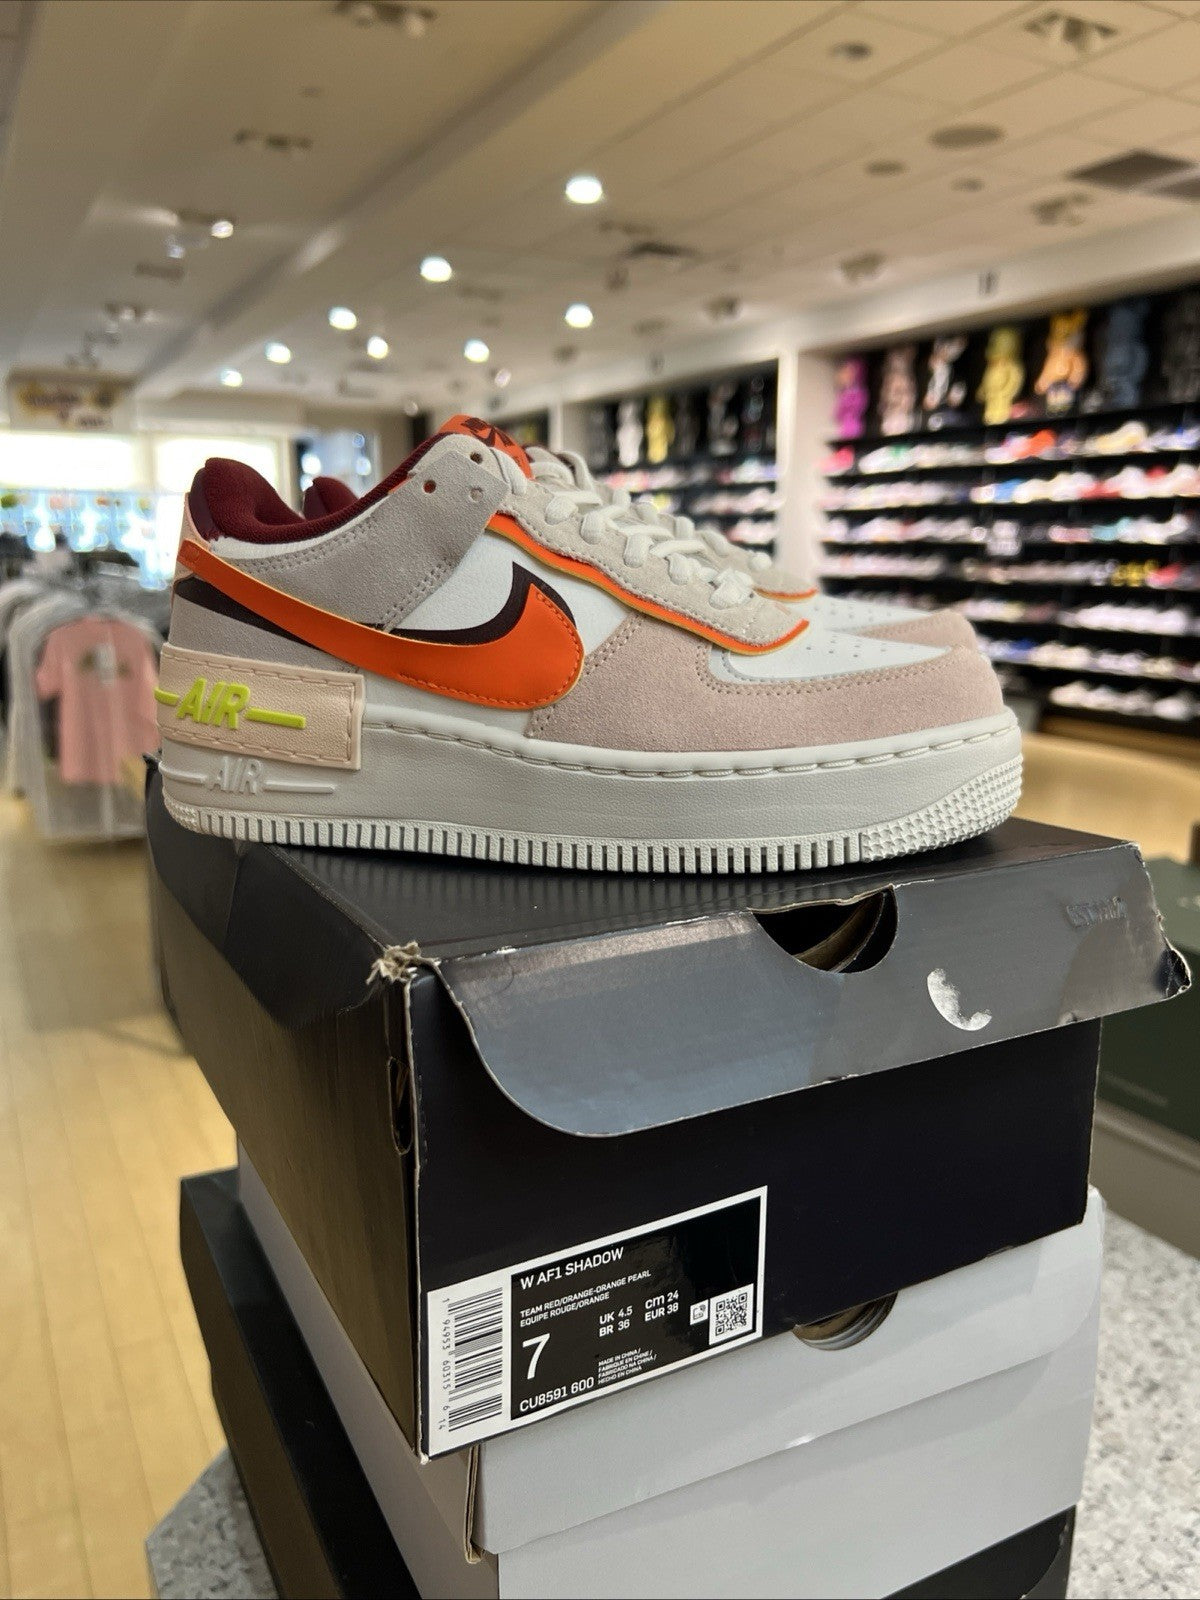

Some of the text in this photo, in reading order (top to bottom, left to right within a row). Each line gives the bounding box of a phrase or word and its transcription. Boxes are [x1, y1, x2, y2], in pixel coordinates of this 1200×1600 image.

[177, 677, 250, 730] AIR
[210, 756, 264, 794] AIR
[520, 1247, 624, 1290] W AF1 SHADOW
[520, 1270, 651, 1318] TEAM RED/ORANGE-ORANGE PEARL
[645, 1290, 679, 1310] cm 24
[520, 1292, 610, 1328] EQUIPE ROUGE/ORANGE
[600, 1306, 633, 1324] UK 4.5
[645, 1302, 679, 1322] EUR 38
[442, 1319, 451, 1350] 94953
[600, 1319, 630, 1338] BR 36
[522, 1333, 550, 1380] 7
[599, 1356, 614, 1366] MADE
[629, 1361, 637, 1369] NA
[442, 1360, 451, 1390] 60315
[520, 1377, 594, 1412] CU8591 600
